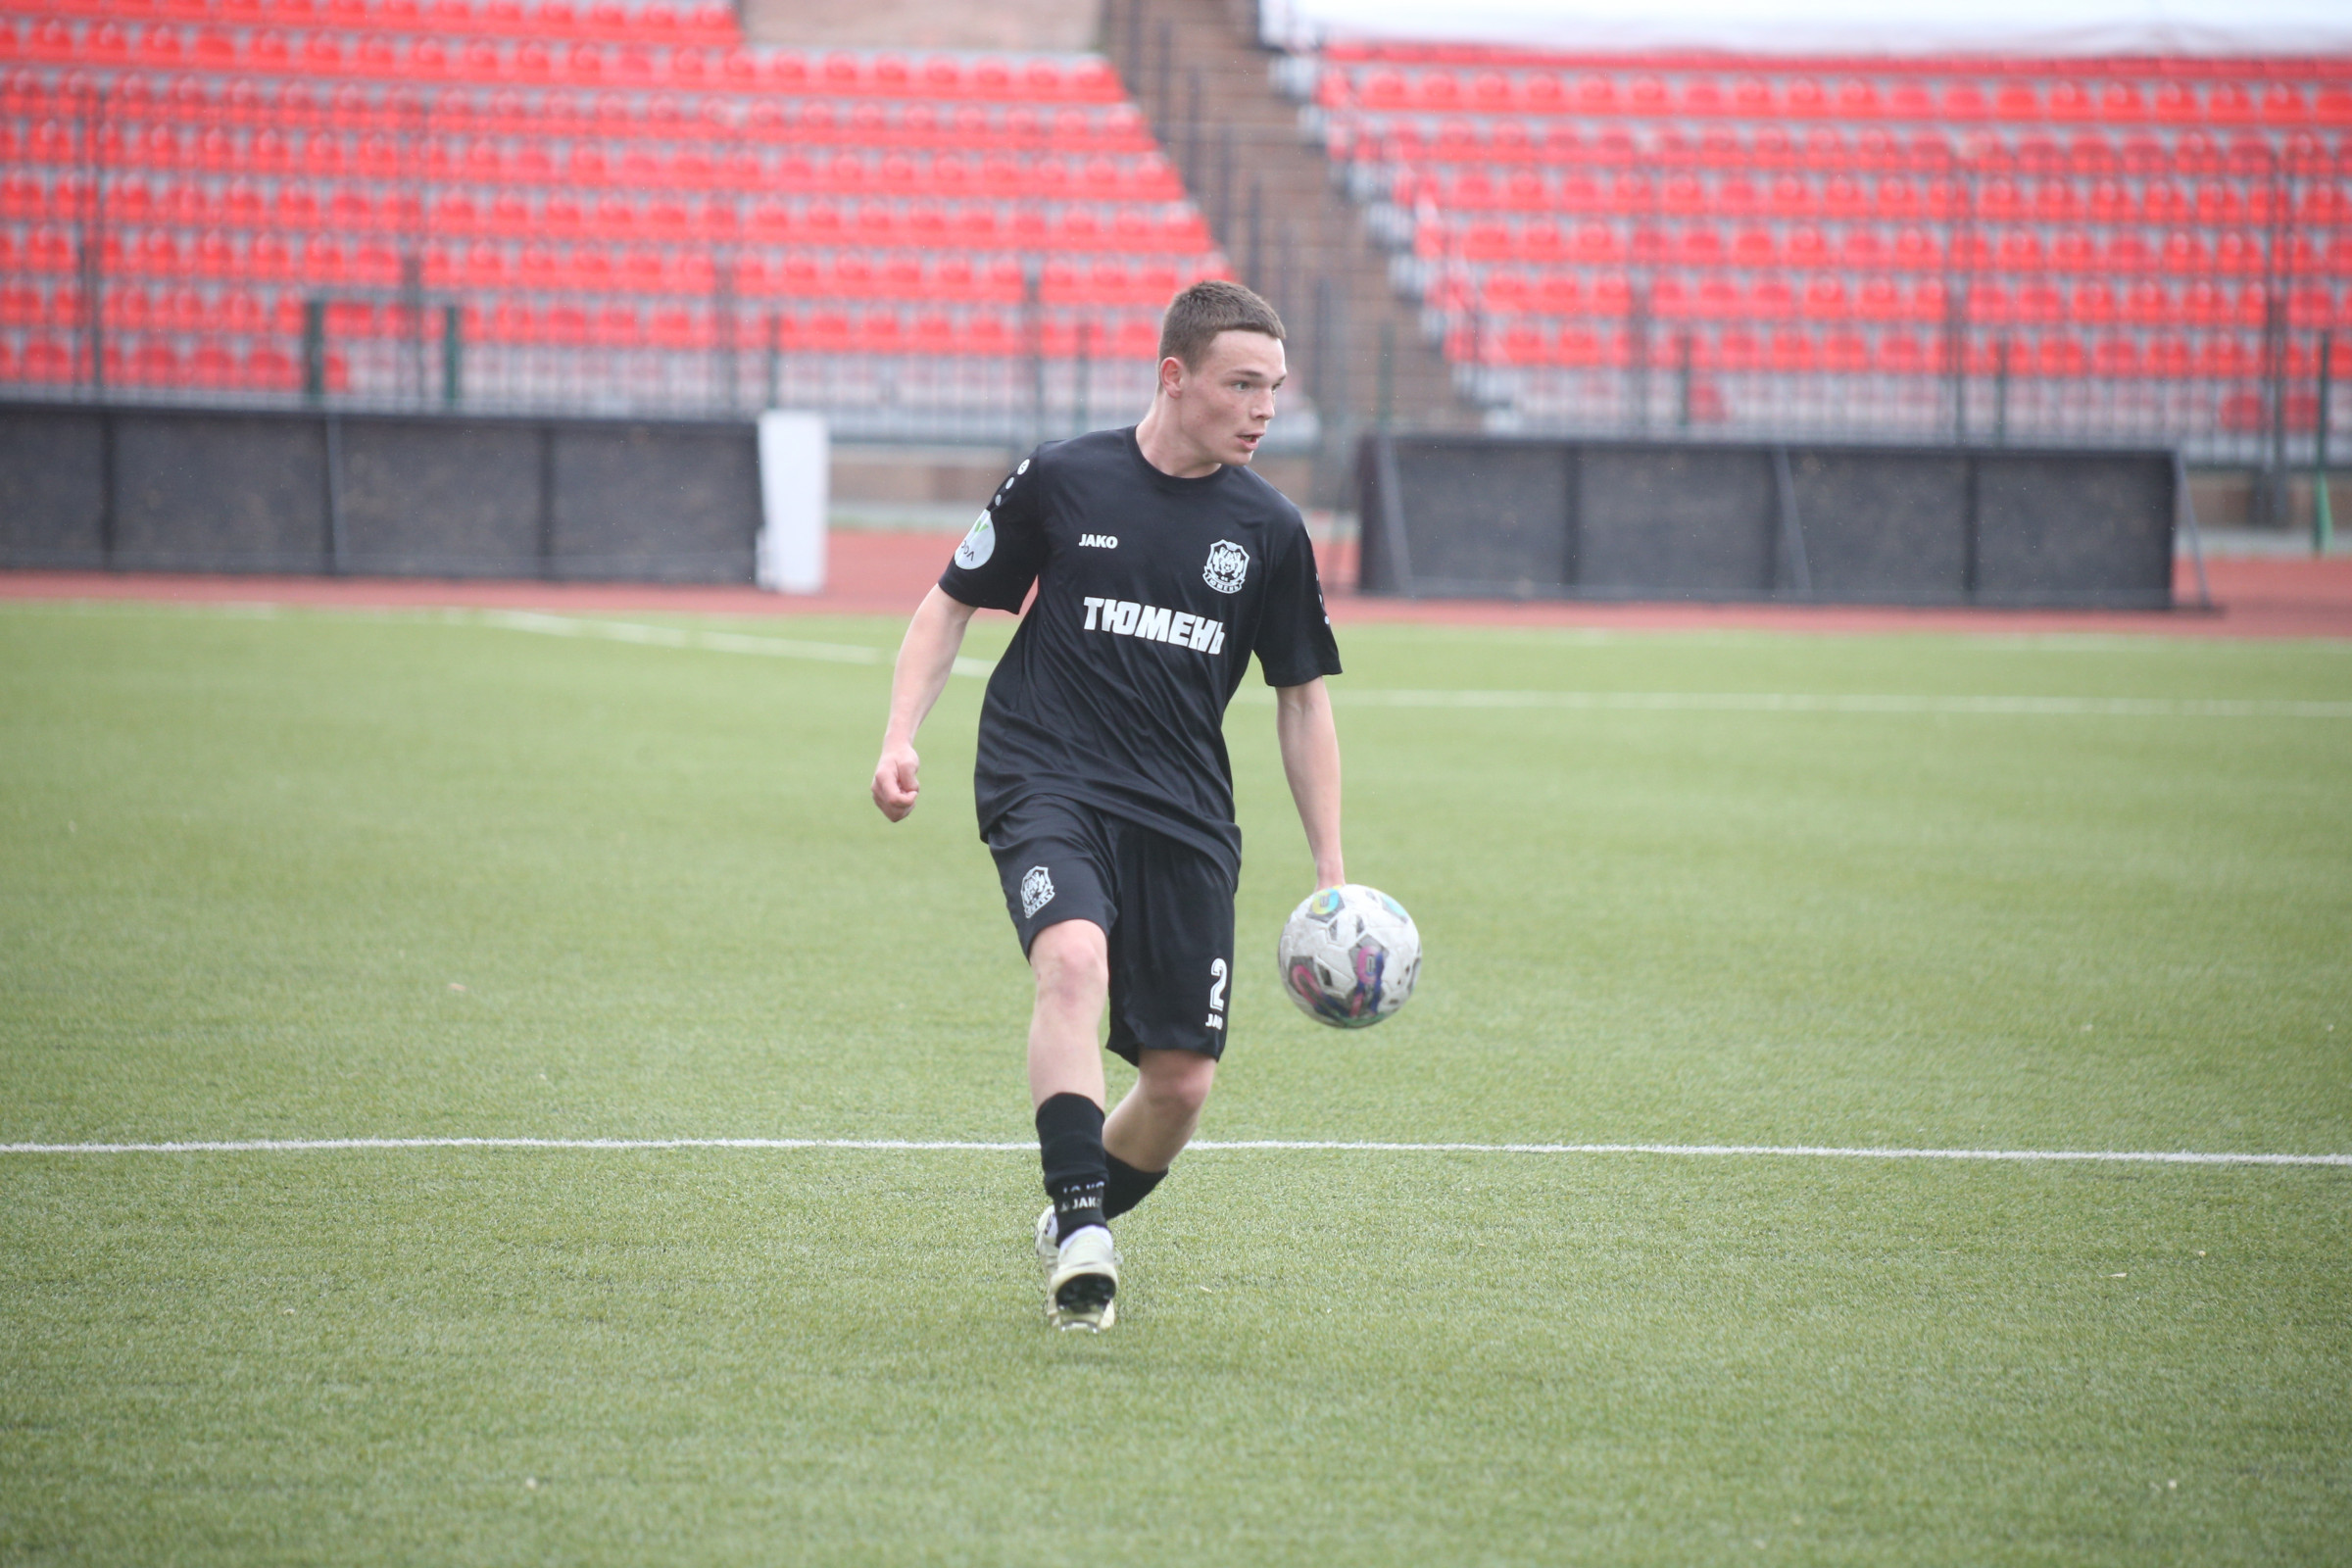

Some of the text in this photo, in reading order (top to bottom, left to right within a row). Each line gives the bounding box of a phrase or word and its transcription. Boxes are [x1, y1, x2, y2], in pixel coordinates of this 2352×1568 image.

[1078, 533, 1118, 549] JAKO
[1083, 596, 1226, 655] ТЮМЕНЬ
[1209, 957, 1228, 1012] 2
